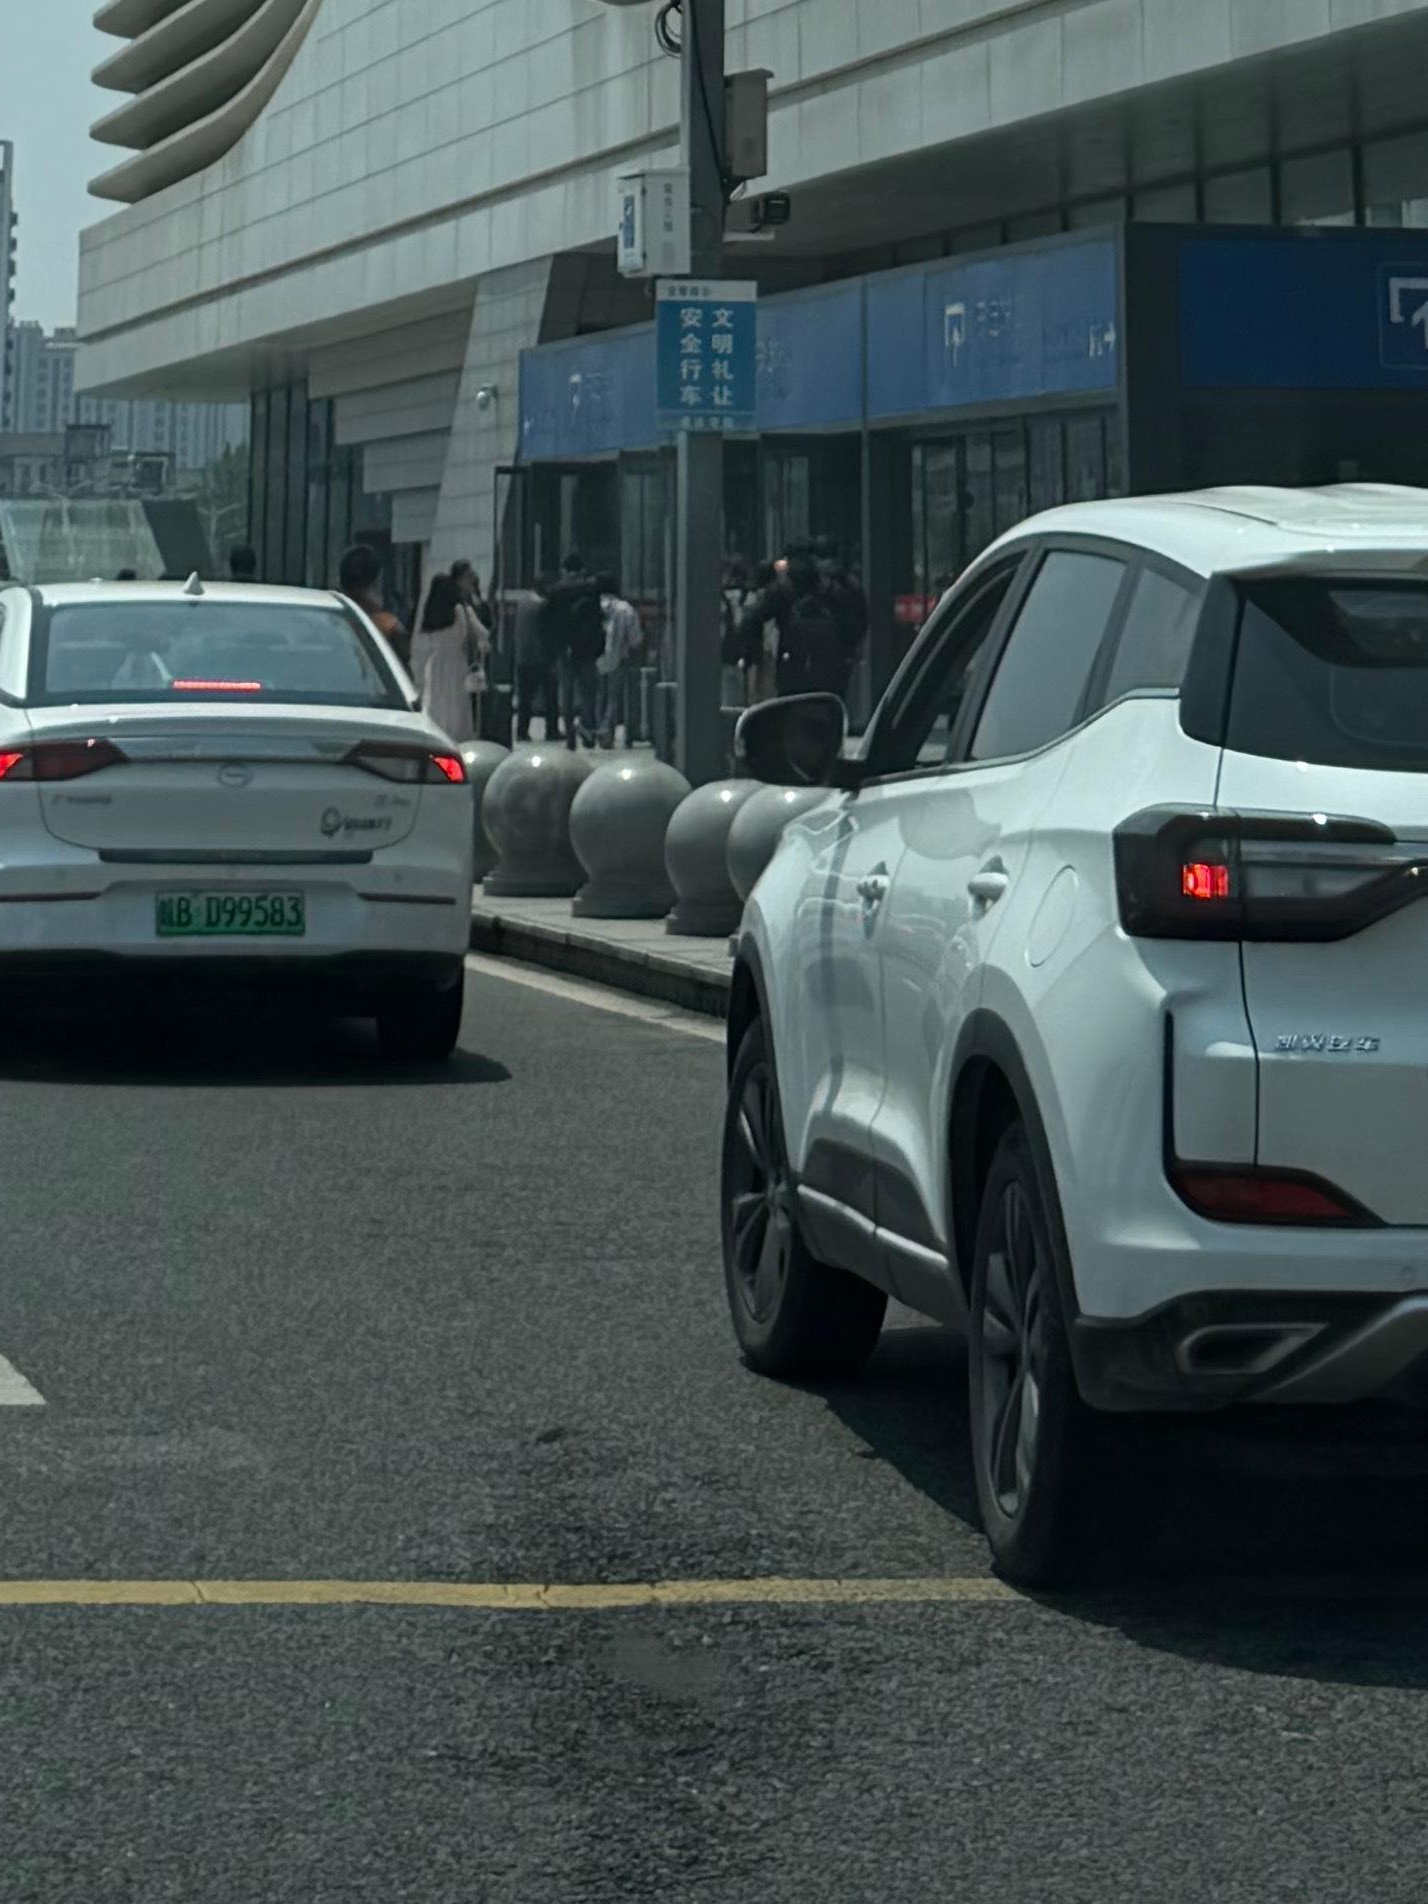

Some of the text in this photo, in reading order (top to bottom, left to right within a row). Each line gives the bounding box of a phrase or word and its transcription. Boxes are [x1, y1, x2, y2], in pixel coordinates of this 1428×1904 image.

[680, 307, 702, 406] 安全行车
[711, 307, 734, 406] 文明礼让
[205, 895, 302, 927] D99583
